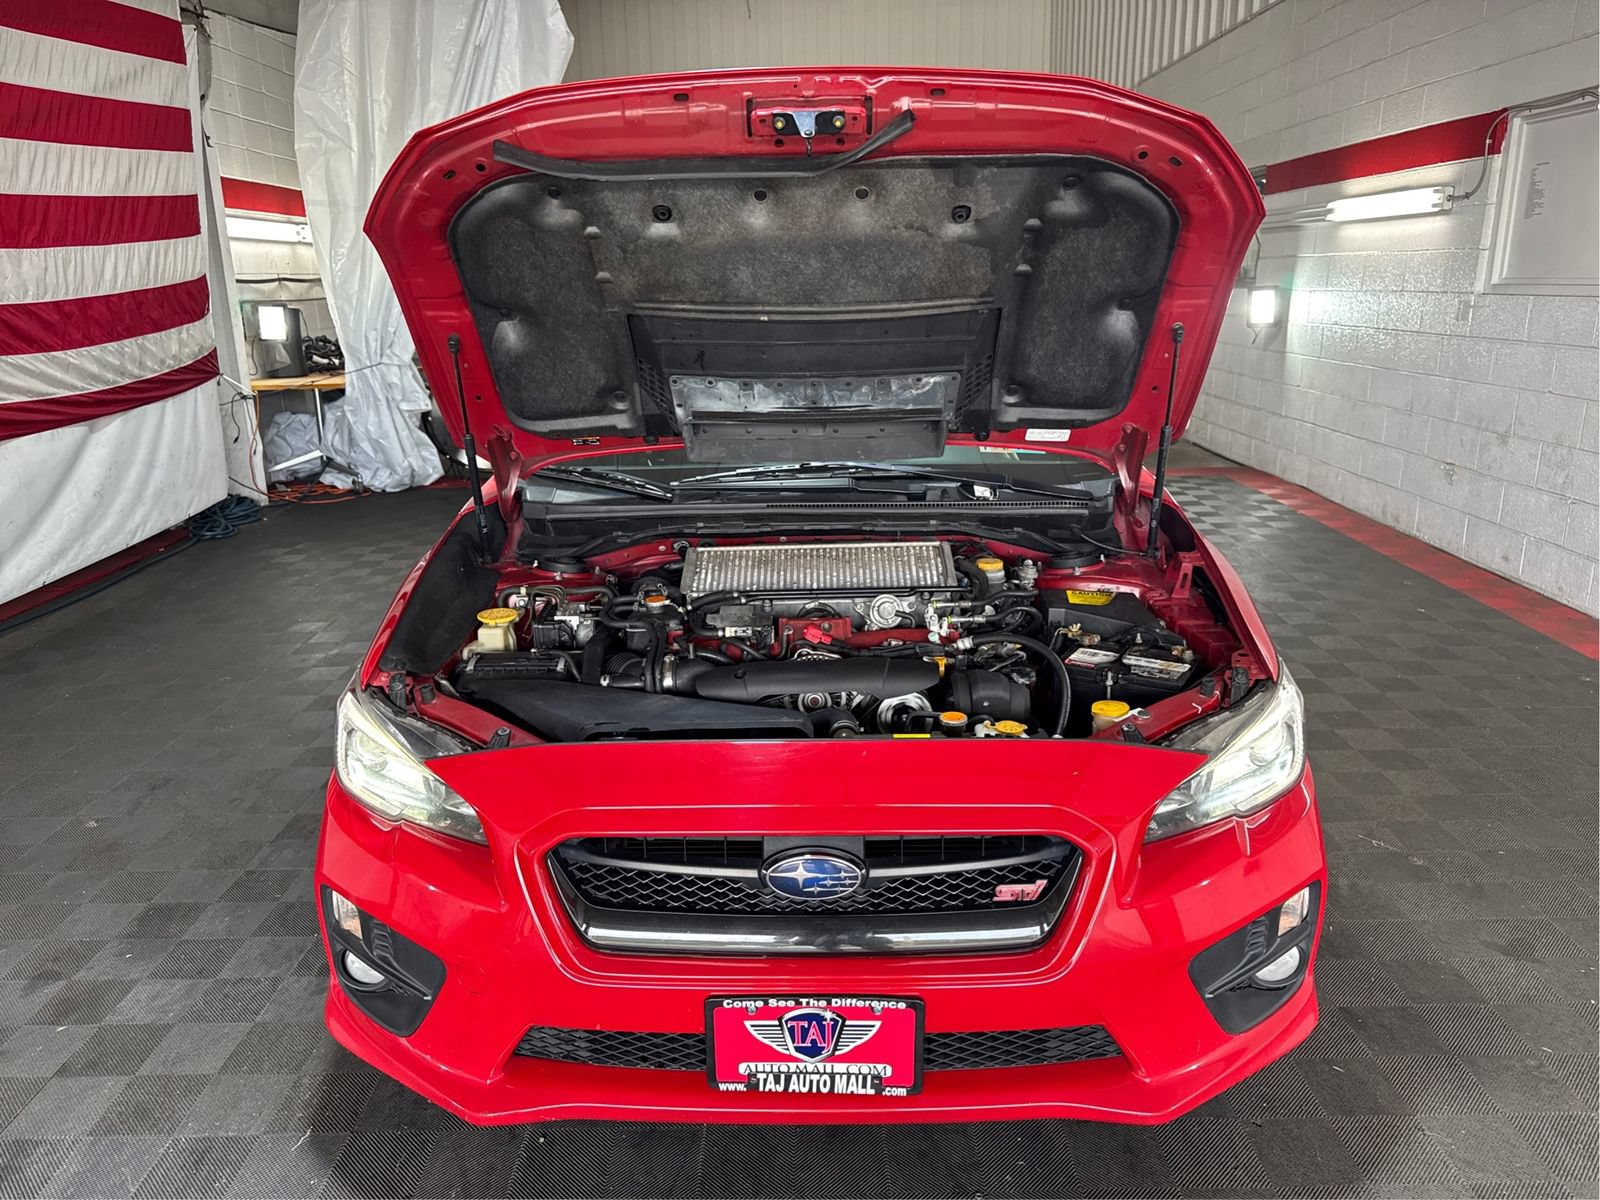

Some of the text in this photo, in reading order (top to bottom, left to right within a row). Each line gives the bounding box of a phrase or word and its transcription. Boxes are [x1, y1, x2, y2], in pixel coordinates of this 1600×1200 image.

[723, 998, 906, 1010] Come See The Difference
[788, 1020, 834, 1055] TAJ
[718, 1073, 907, 1097] www. TAJ AUTO MALL .com
